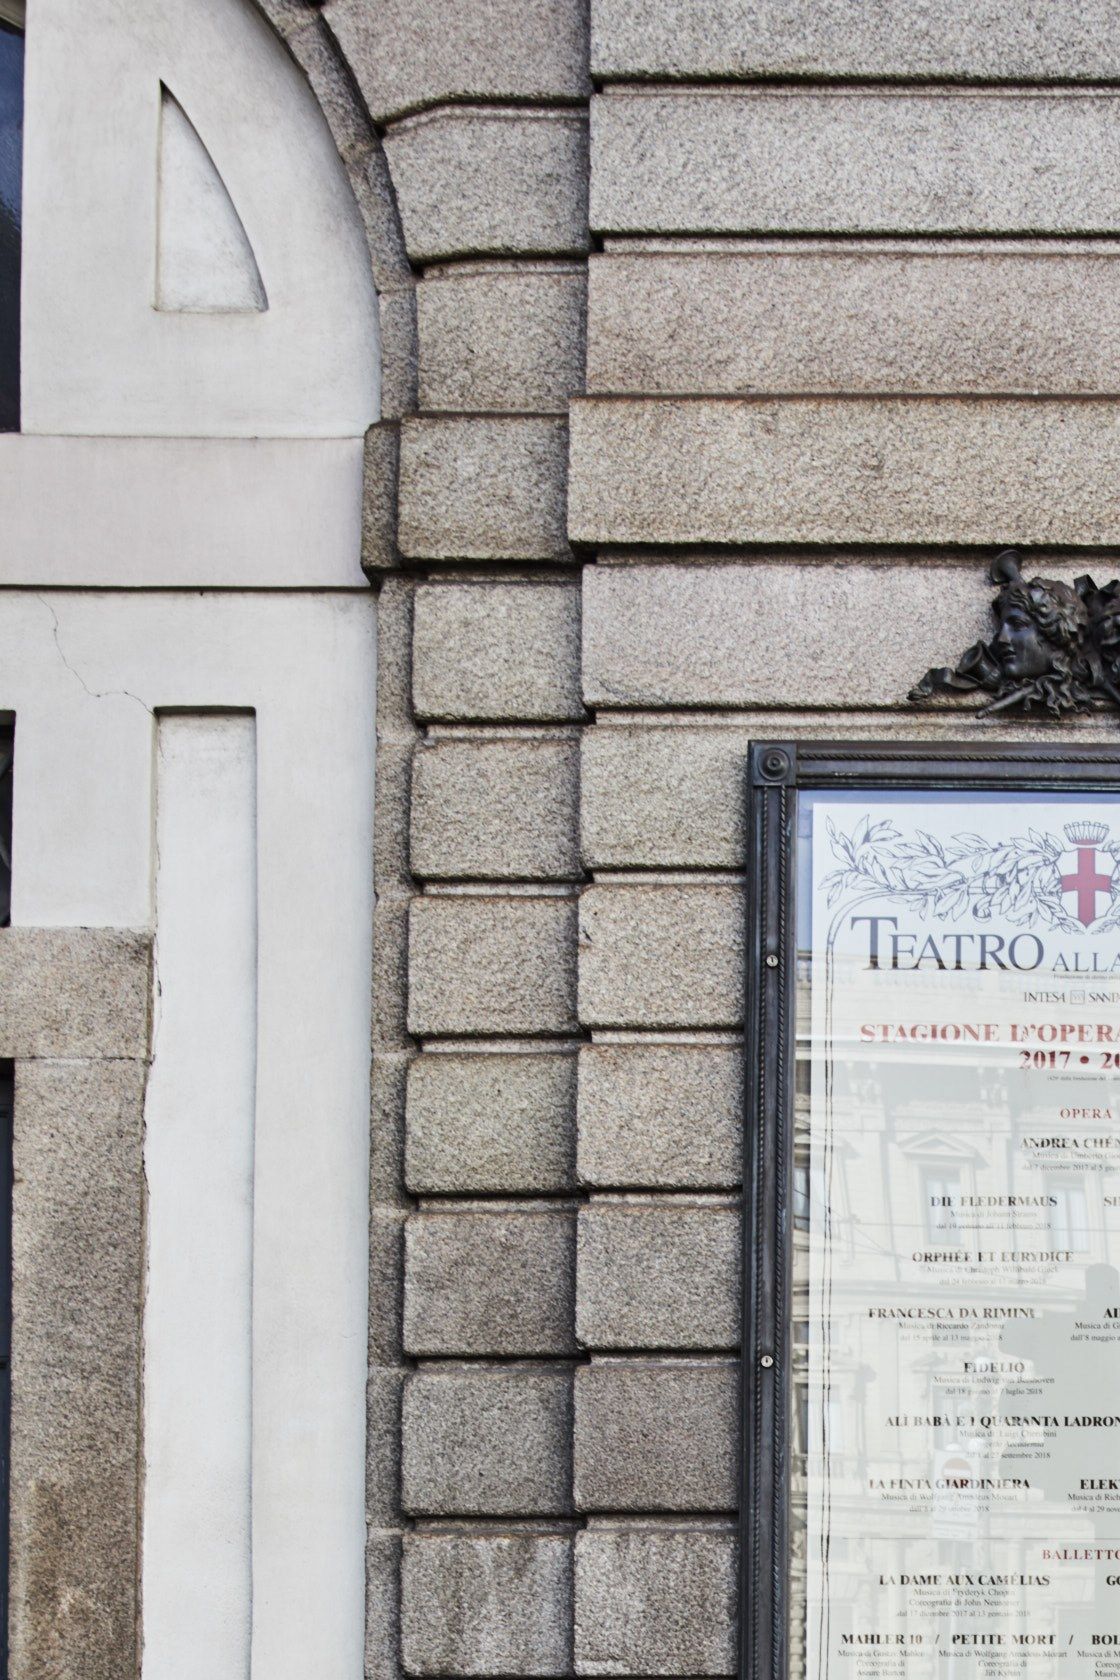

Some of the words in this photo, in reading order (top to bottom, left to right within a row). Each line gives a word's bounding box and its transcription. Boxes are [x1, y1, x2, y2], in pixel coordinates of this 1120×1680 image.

[851, 916, 1044, 972] TEATRO
[1024, 992, 1065, 1003] INTESA
[860, 1024, 998, 1044] STAGIONE
[1018, 1051, 1071, 1070] 2017
[1060, 1108, 1112, 1120] OPERA
[1020, 1137, 1079, 1149] ANDREA
[931, 1196, 954, 1208] DIE
[960, 1196, 1058, 1208] FLEDERMAUS
[912, 1250, 972, 1263] ORPHÉE
[978, 1252, 996, 1263] ET
[1002, 1252, 1073, 1263] EURYDICE
[868, 1307, 954, 1319] FRANCESCA
[959, 1307, 978, 1319] DA
[1092, 1335, 1116, 1344] maggio
[964, 1362, 1025, 1374] FIDELIO
[956, 1416, 965, 1427] E
[980, 1416, 1059, 1429] QUARANTA
[869, 1479, 886, 1490] LA
[890, 1479, 932, 1490] FINTA
[936, 1479, 1030, 1490] GIARDINIERA
[879, 1575, 896, 1586] LA
[900, 1575, 942, 1586] DAME
[946, 1575, 975, 1586] AUX
[978, 1572, 1051, 1586] CAMÉLIAS
[965, 1599, 981, 1607] John
[841, 1634, 905, 1646] MAHLER
[909, 1634, 923, 1646] 10
[952, 1634, 1006, 1646] PETITE
[1011, 1634, 1056, 1646] MORT
